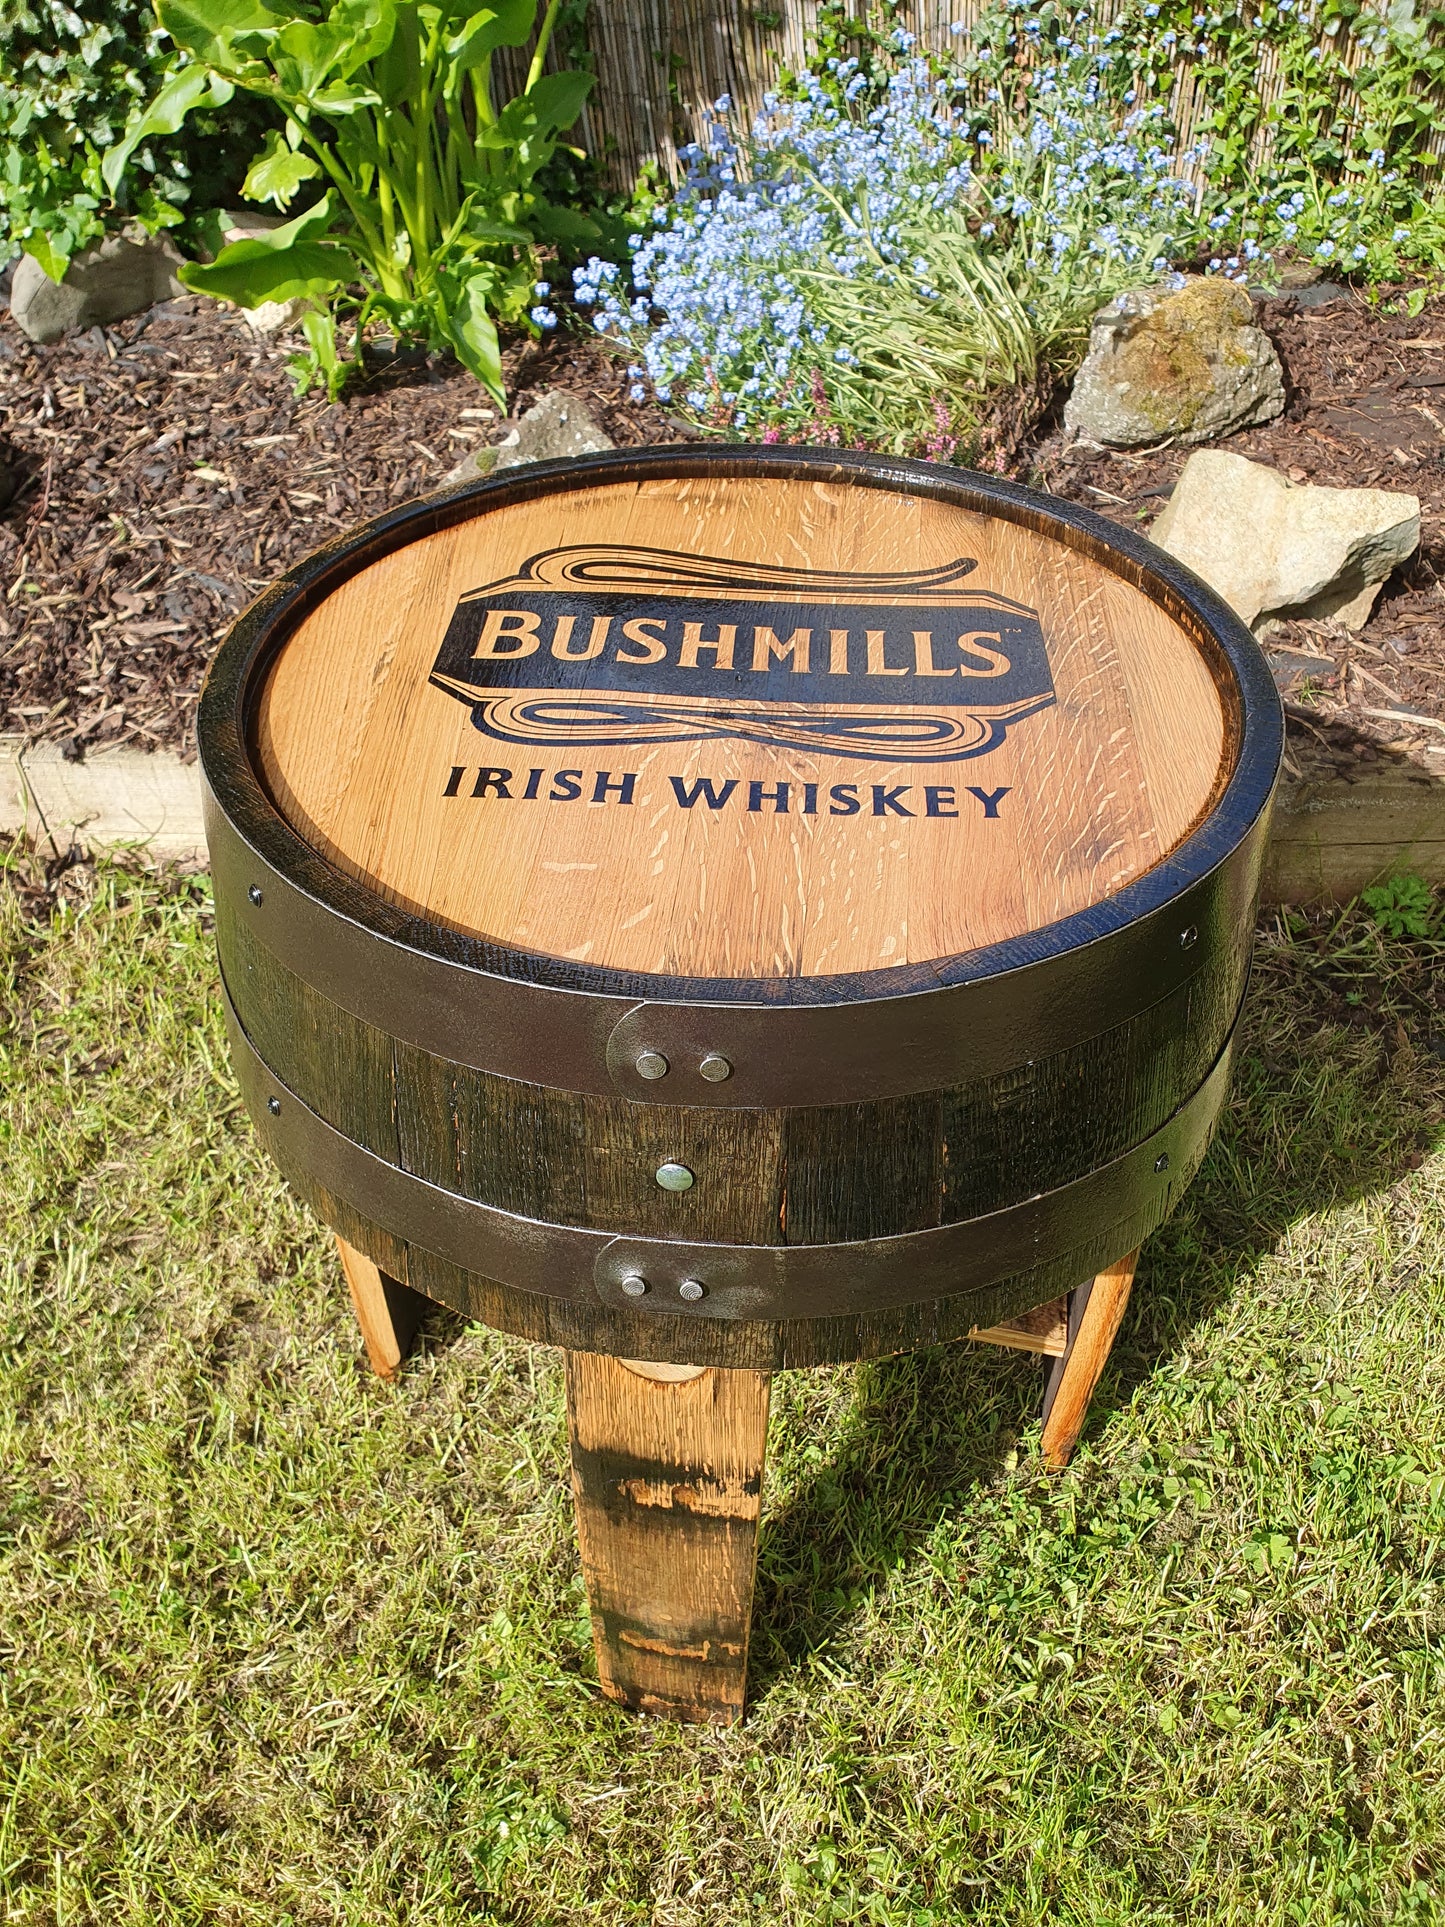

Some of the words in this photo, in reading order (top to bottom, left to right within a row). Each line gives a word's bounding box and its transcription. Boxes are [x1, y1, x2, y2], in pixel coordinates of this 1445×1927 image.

[470, 609, 1011, 678] BUSHMILLS
[442, 765, 638, 804] IRISH
[668, 775, 1012, 819] WHISKEY
